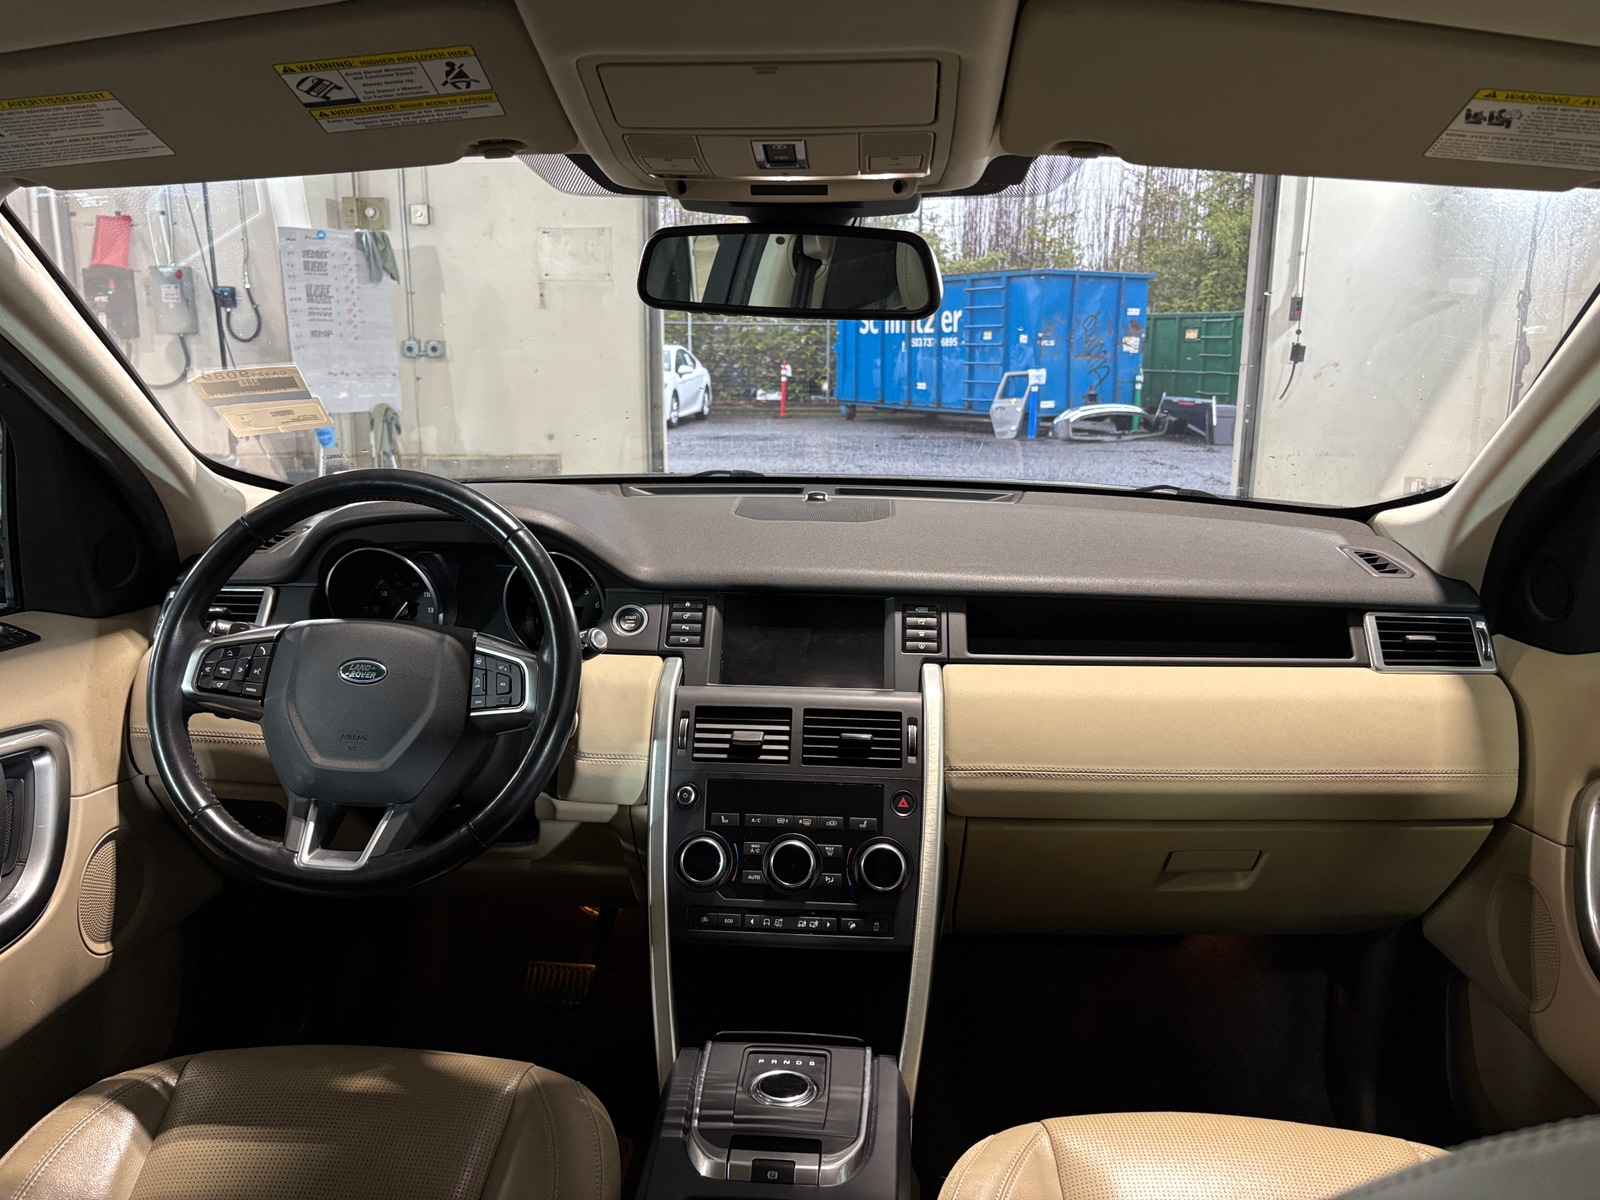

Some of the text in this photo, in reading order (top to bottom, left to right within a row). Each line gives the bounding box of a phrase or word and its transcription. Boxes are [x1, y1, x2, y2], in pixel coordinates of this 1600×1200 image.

[359, 57, 396, 66] HIGHER
[399, 53, 446, 62] ROLLOVER
[447, 50, 470, 58] RISK
[7, 92, 106, 108] AVERTISSEMENT
[584, 588, 590, 596] 5
[594, 601, 600, 610] 6
[340, 733, 368, 742] AIRBAG
